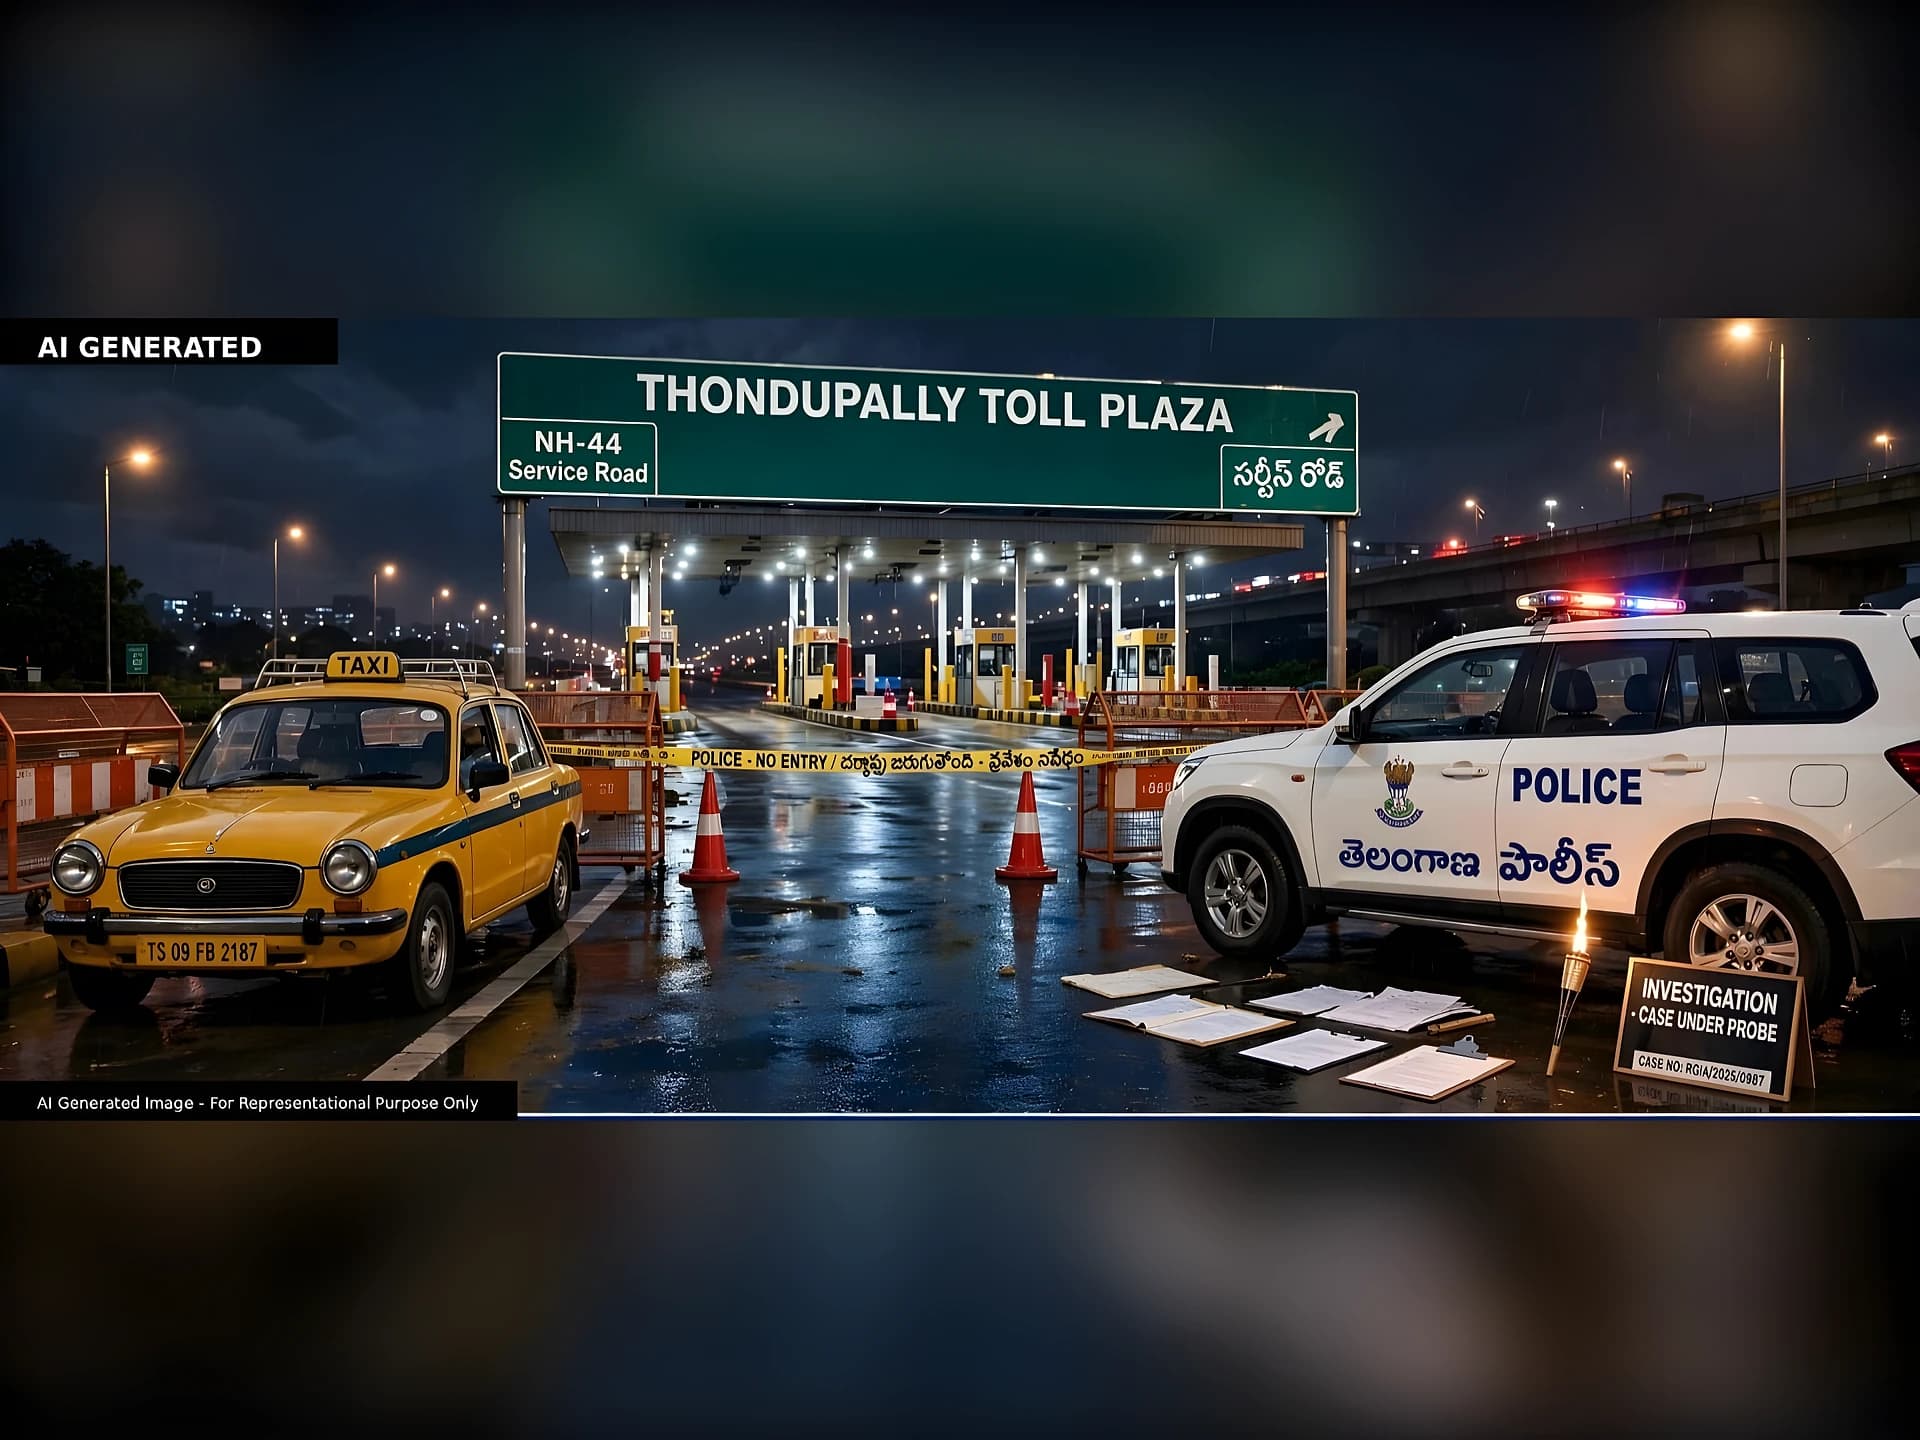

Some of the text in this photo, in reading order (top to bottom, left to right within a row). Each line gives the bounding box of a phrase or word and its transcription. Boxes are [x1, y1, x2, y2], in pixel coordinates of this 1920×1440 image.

[637, 373, 1234, 433] THONDUPALLY TOLL PLAZA
[534, 431, 622, 455] NH-44
[508, 459, 648, 484] Service Road
[337, 656, 389, 675] TAXI
[691, 751, 742, 767] POLICE
[755, 753, 776, 768] NO
[781, 754, 827, 770] ENTRY
[1513, 767, 1642, 805] POLICE
[1339, 839, 1480, 877] తెలంగాణ
[147, 942, 258, 962] TS 09 FB 2187
[1642, 977, 1778, 1015] INVESTIGATION
[1638, 1005, 1778, 1043] CASE UNDER PROBE
[1638, 1055, 1664, 1070] CASE
[1685, 1062, 1765, 1087] RGIA/2025/0987
